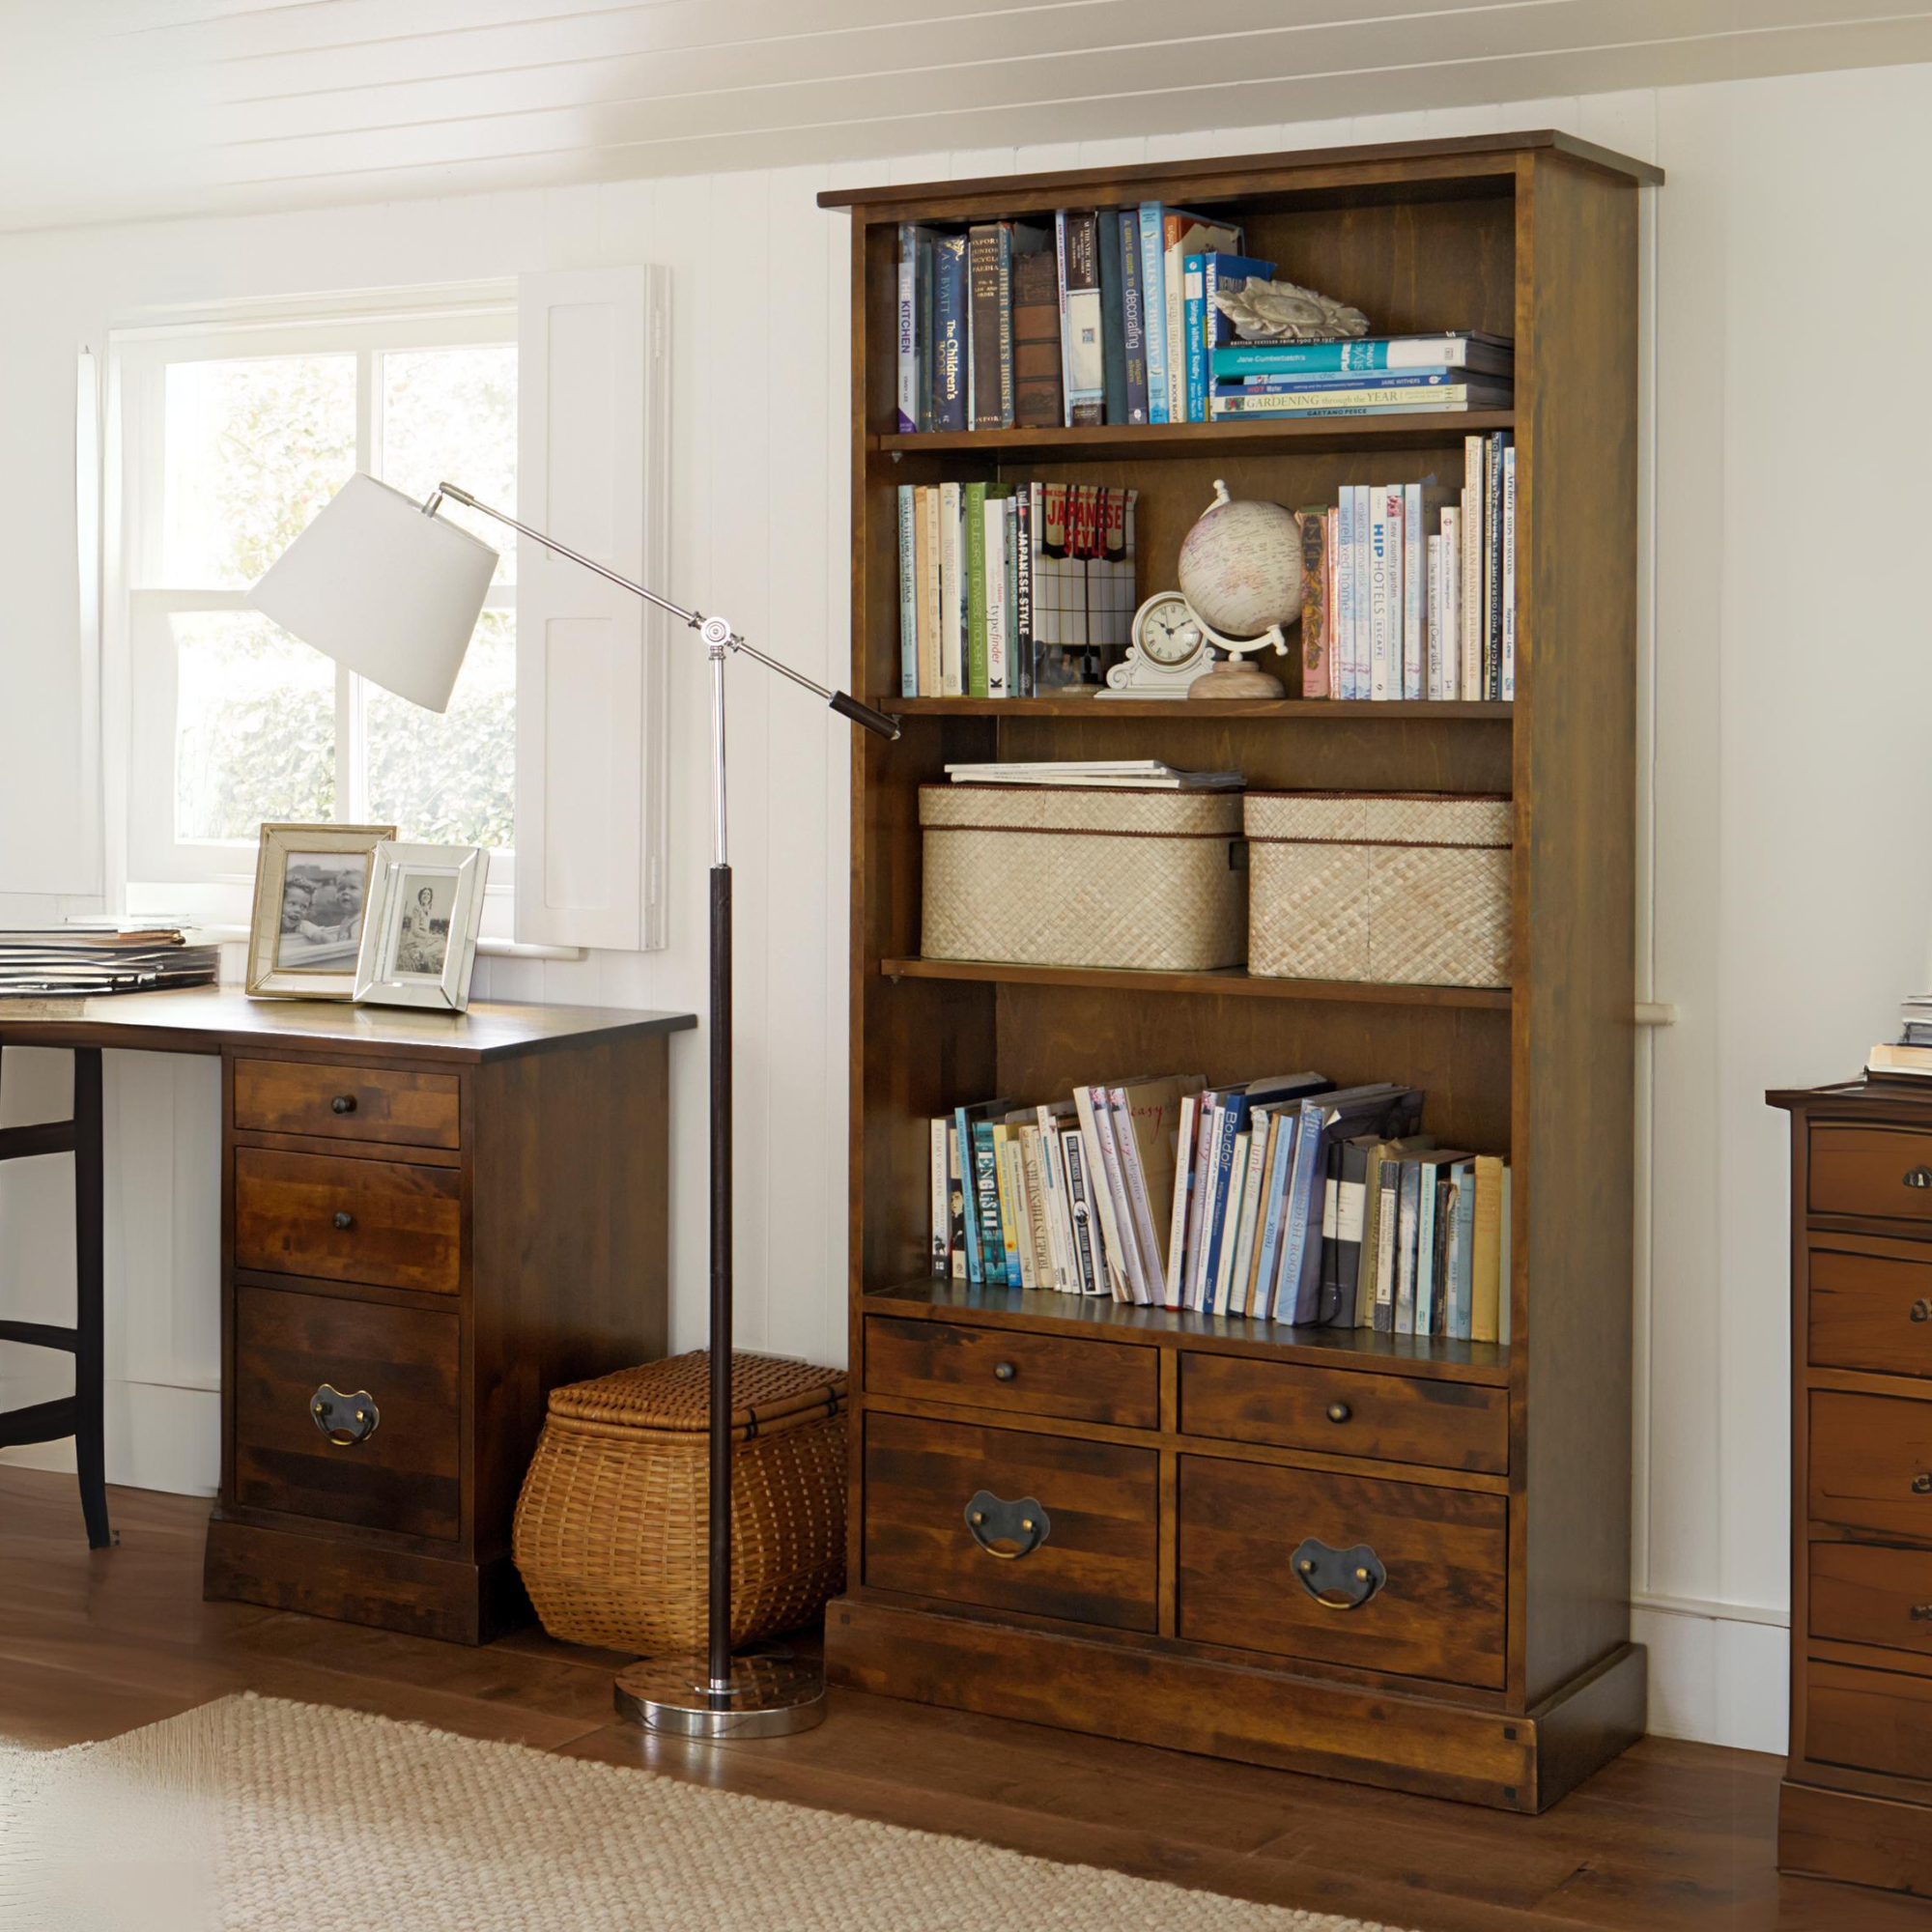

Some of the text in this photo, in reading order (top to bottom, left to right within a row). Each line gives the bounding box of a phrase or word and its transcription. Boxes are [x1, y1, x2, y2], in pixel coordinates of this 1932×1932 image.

[1084, 221, 1093, 259] AUTHENTIC
[1145, 239, 1157, 284] STYLE
[941, 277, 951, 313] BYATT
[999, 269, 1009, 306] OTHER
[1127, 278, 1134, 287] TO
[901, 275, 912, 354] THE KITCHEN
[1124, 290, 1141, 350] decorating
[1206, 263, 1216, 350] WEIMARANERS
[1147, 285, 1160, 370] CARIBBEAN
[1189, 300, 1201, 380] Siblings Without Rivalry
[937, 341, 947, 376] BOOK
[947, 320, 958, 400] The Children's
[1236, 355, 1254, 363] Jane
[1351, 342, 1367, 370] style
[1001, 364, 1011, 410] HOUSES
[1246, 395, 1320, 409] GARDENING
[1322, 394, 1352, 407] through
[1353, 395, 1367, 404] the
[1366, 390, 1399, 403] YEAR
[1307, 407, 1367, 417] GAETANO PESCE
[1507, 471, 1516, 512] Archery
[1046, 500, 1123, 530] JAPANESE
[1467, 482, 1478, 567] SCANDINAVIAN
[1064, 528, 1108, 558] STYLE
[1341, 523, 1353, 569] relaxed
[1373, 524, 1384, 558] HIP
[1389, 539, 1399, 569] country
[1507, 537, 1513, 547] TO
[929, 521, 938, 617] FIFTIES
[1017, 530, 1030, 635] JAPANESE STYLE
[1373, 560, 1385, 614] HOTELS
[1389, 571, 1400, 599] garden
[1342, 573, 1353, 611] home
[1468, 568, 1478, 614] PAINTED
[1468, 616, 1478, 680] FURNITURE
[1130, 1105, 1164, 1146] easy
[1220, 1111, 1238, 1172] Boudoir
[1068, 1137, 1084, 1199] THE PRINCESS BRIDE
[1108, 1157, 1124, 1202] elegance
[1128, 1158, 1144, 1204] elegance
[1178, 1157, 1186, 1185] CROSS
[1247, 1143, 1264, 1199] junk style
[1024, 1159, 1044, 1225] THESAURUS
[1175, 1186, 1185, 1217] STITCH
[1079, 1226, 1090, 1251] WILLIAM
[1212, 1202, 1221, 1236] Robertson
[1264, 1221, 1275, 1248] relax
[1287, 1243, 1299, 1284] ROOM
